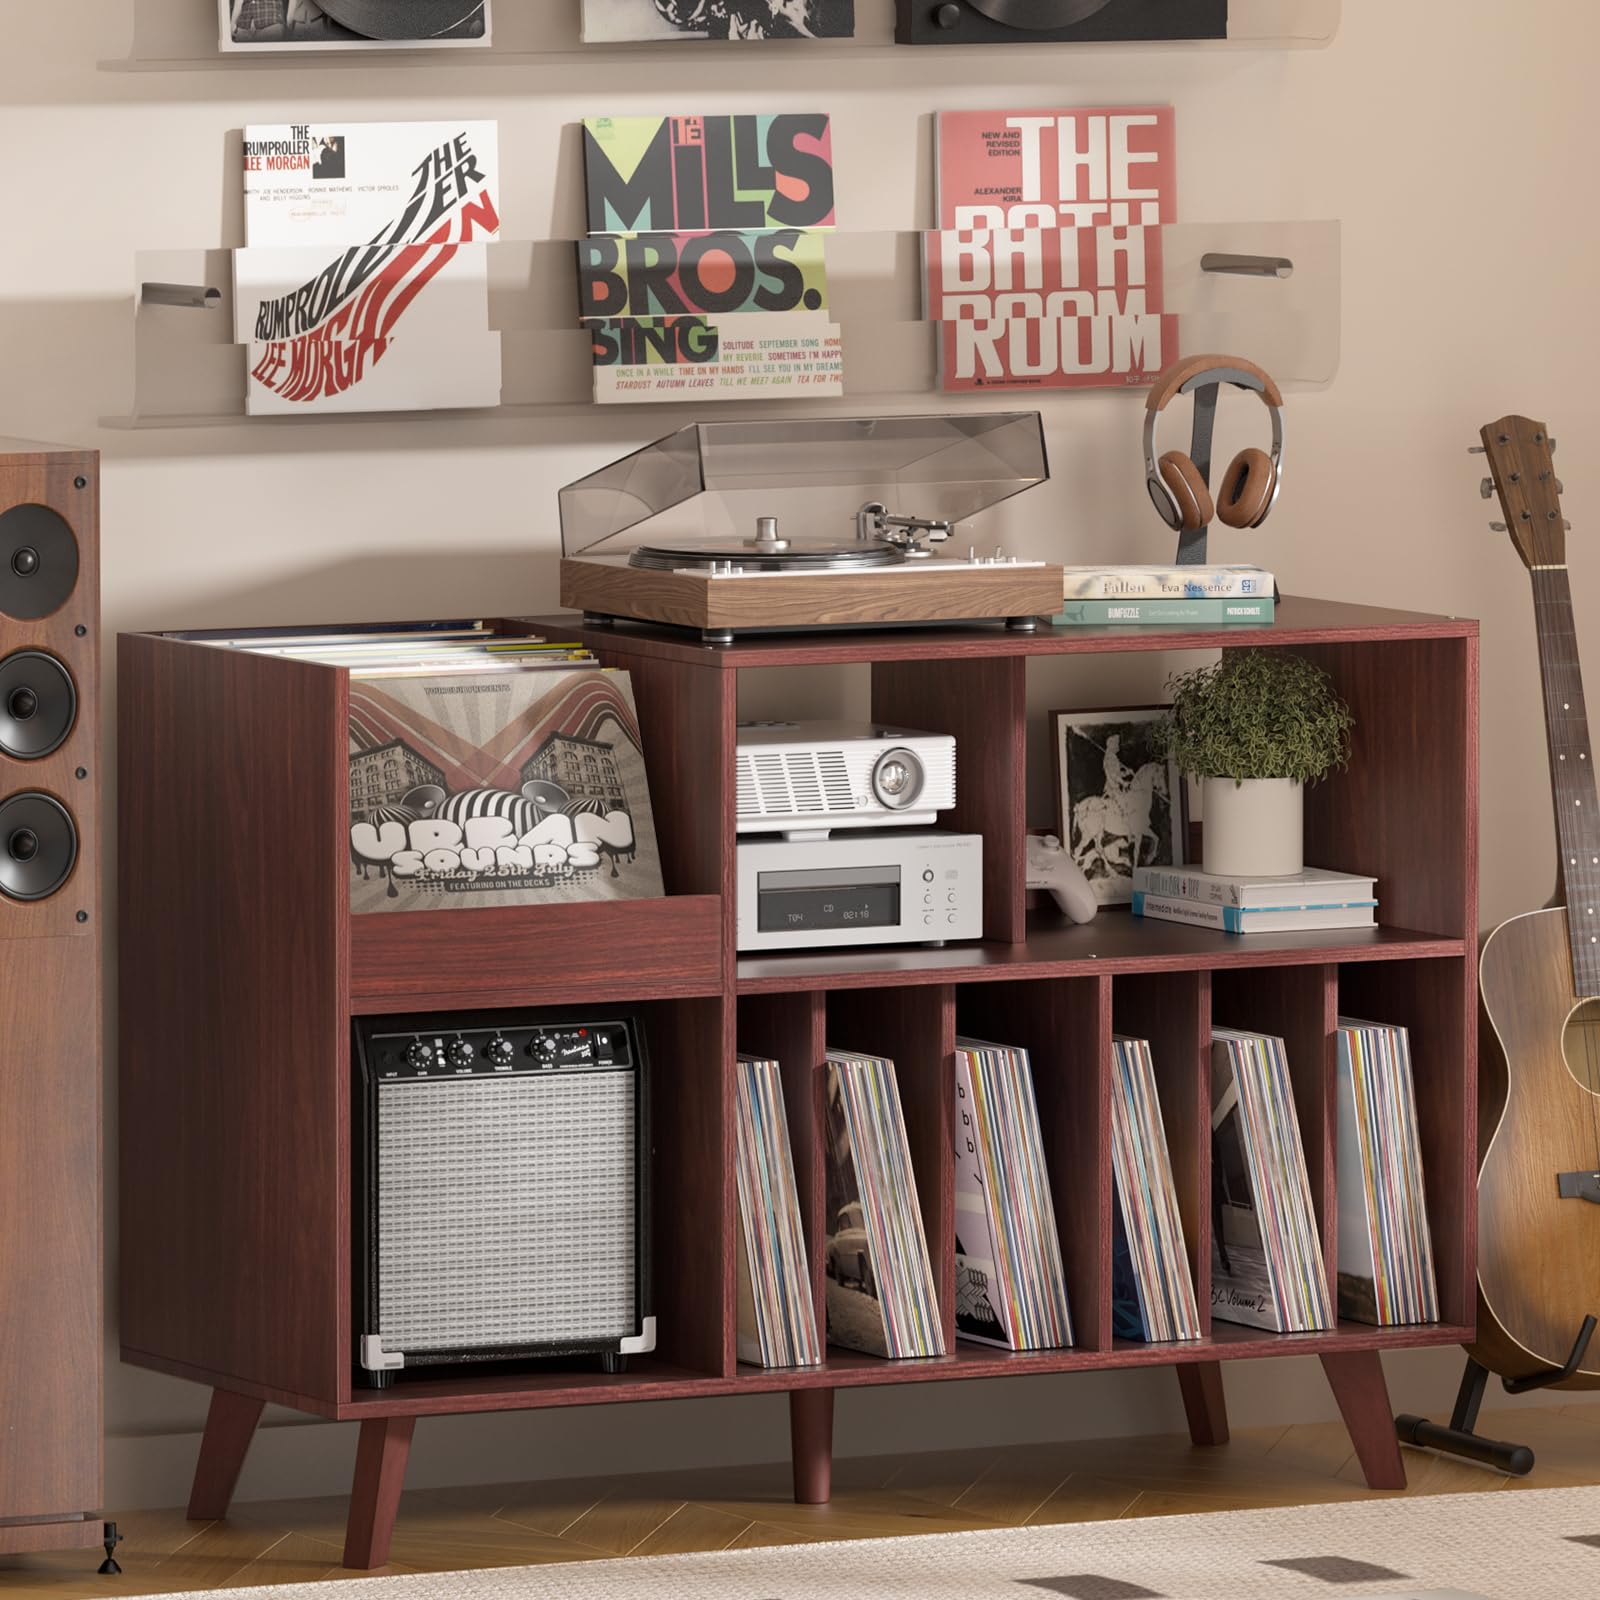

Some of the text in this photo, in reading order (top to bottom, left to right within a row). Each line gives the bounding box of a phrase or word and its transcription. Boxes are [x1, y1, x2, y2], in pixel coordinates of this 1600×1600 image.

[290, 125, 310, 140] THE
[982, 132, 1001, 140] NEW
[244, 140, 310, 156] RUMPROLLER
[244, 155, 310, 171] LEE MORGAN
[1006, 115, 1159, 201] THE
[583, 113, 834, 232] MILLS
[974, 187, 1022, 195] ALEXANDER
[941, 201, 1159, 292] BATH
[578, 229, 823, 316] BROS.
[584, 316, 719, 366] SING
[942, 289, 1162, 378] ROOM
[723, 341, 754, 350] SOLITUDE
[759, 339, 797, 348] SEPTEMBER
[801, 338, 819, 347] SONG
[723, 353, 733, 361] MY
[736, 352, 762, 361] REVERIE
[768, 351, 806, 361] SOMETIMES
[616, 369, 634, 378] ONCE
[637, 368, 643, 376] IN
[647, 368, 651, 376] A
[654, 367, 674, 376] WHILE
[679, 367, 694, 375] TIME
[709, 366, 719, 374] MY
[722, 366, 744, 375] HANDS
[764, 364, 776, 372] SEE
[779, 364, 791, 372] YOU
[803, 363, 813, 371] MY
[616, 381, 651, 390] STARDUST
[656, 379, 685, 388] AUTUMN
[688, 378, 714, 388] LEAVES
[720, 378, 733, 386] TILL
[736, 378, 747, 386] WE
[750, 377, 769, 385] MEET
[772, 376, 793, 385] AGAIN
[797, 375, 810, 384] TEA
[813, 374, 827, 383] FOR
[1103, 582, 1146, 594] Fallen
[1161, 584, 1232, 592] Eva Nessence
[350, 810, 634, 860] URBAN
[390, 842, 600, 876] SOUNDS
[414, 863, 575, 882] Friday 25th July
[449, 881, 494, 891] FEATURING
[524, 879, 550, 887] DECKS
[823, 904, 834, 913] CD
[1257, 1294, 1267, 1312] 2
